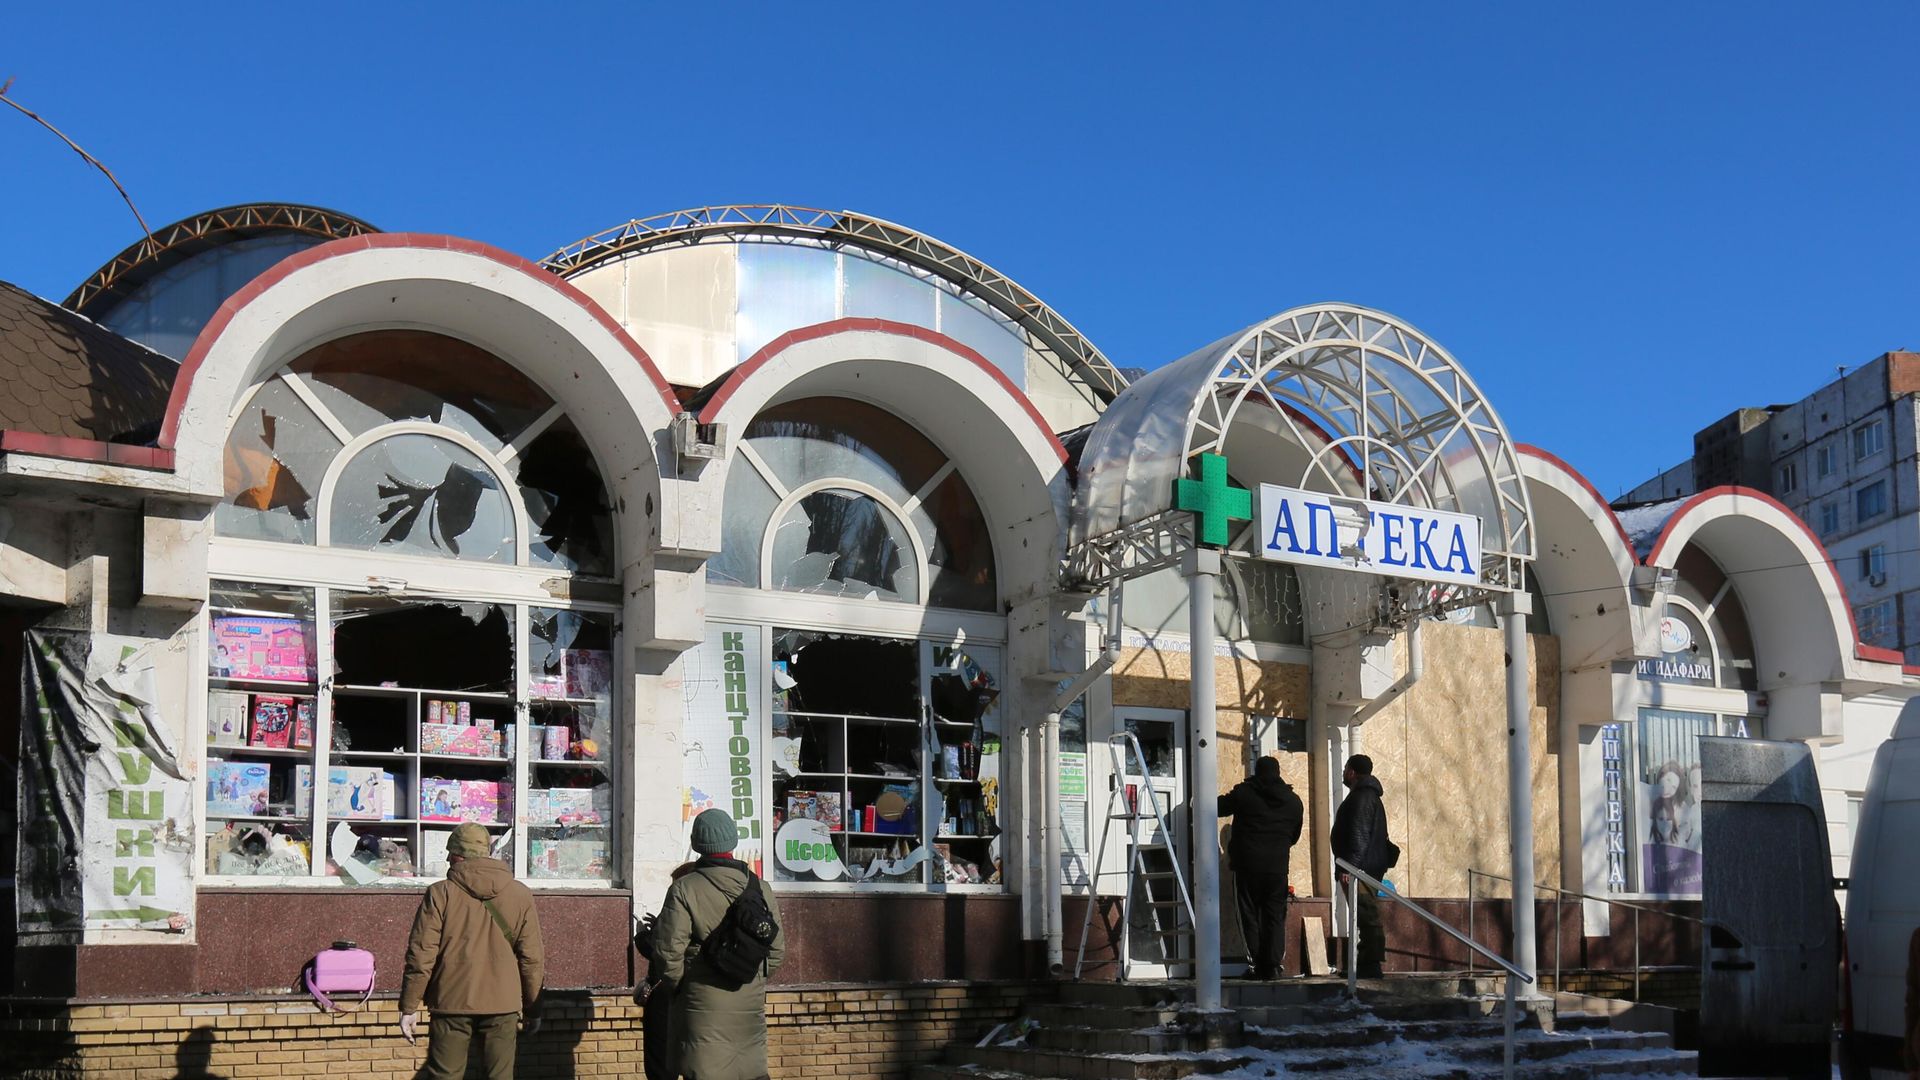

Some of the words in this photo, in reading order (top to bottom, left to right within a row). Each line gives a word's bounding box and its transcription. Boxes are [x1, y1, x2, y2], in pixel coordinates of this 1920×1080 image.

[1267, 498, 1476, 576] АПЕКА
[1638, 660, 1712, 680] ИСИДАФАРМ
[1602, 724, 1626, 885] ПТЕКА
